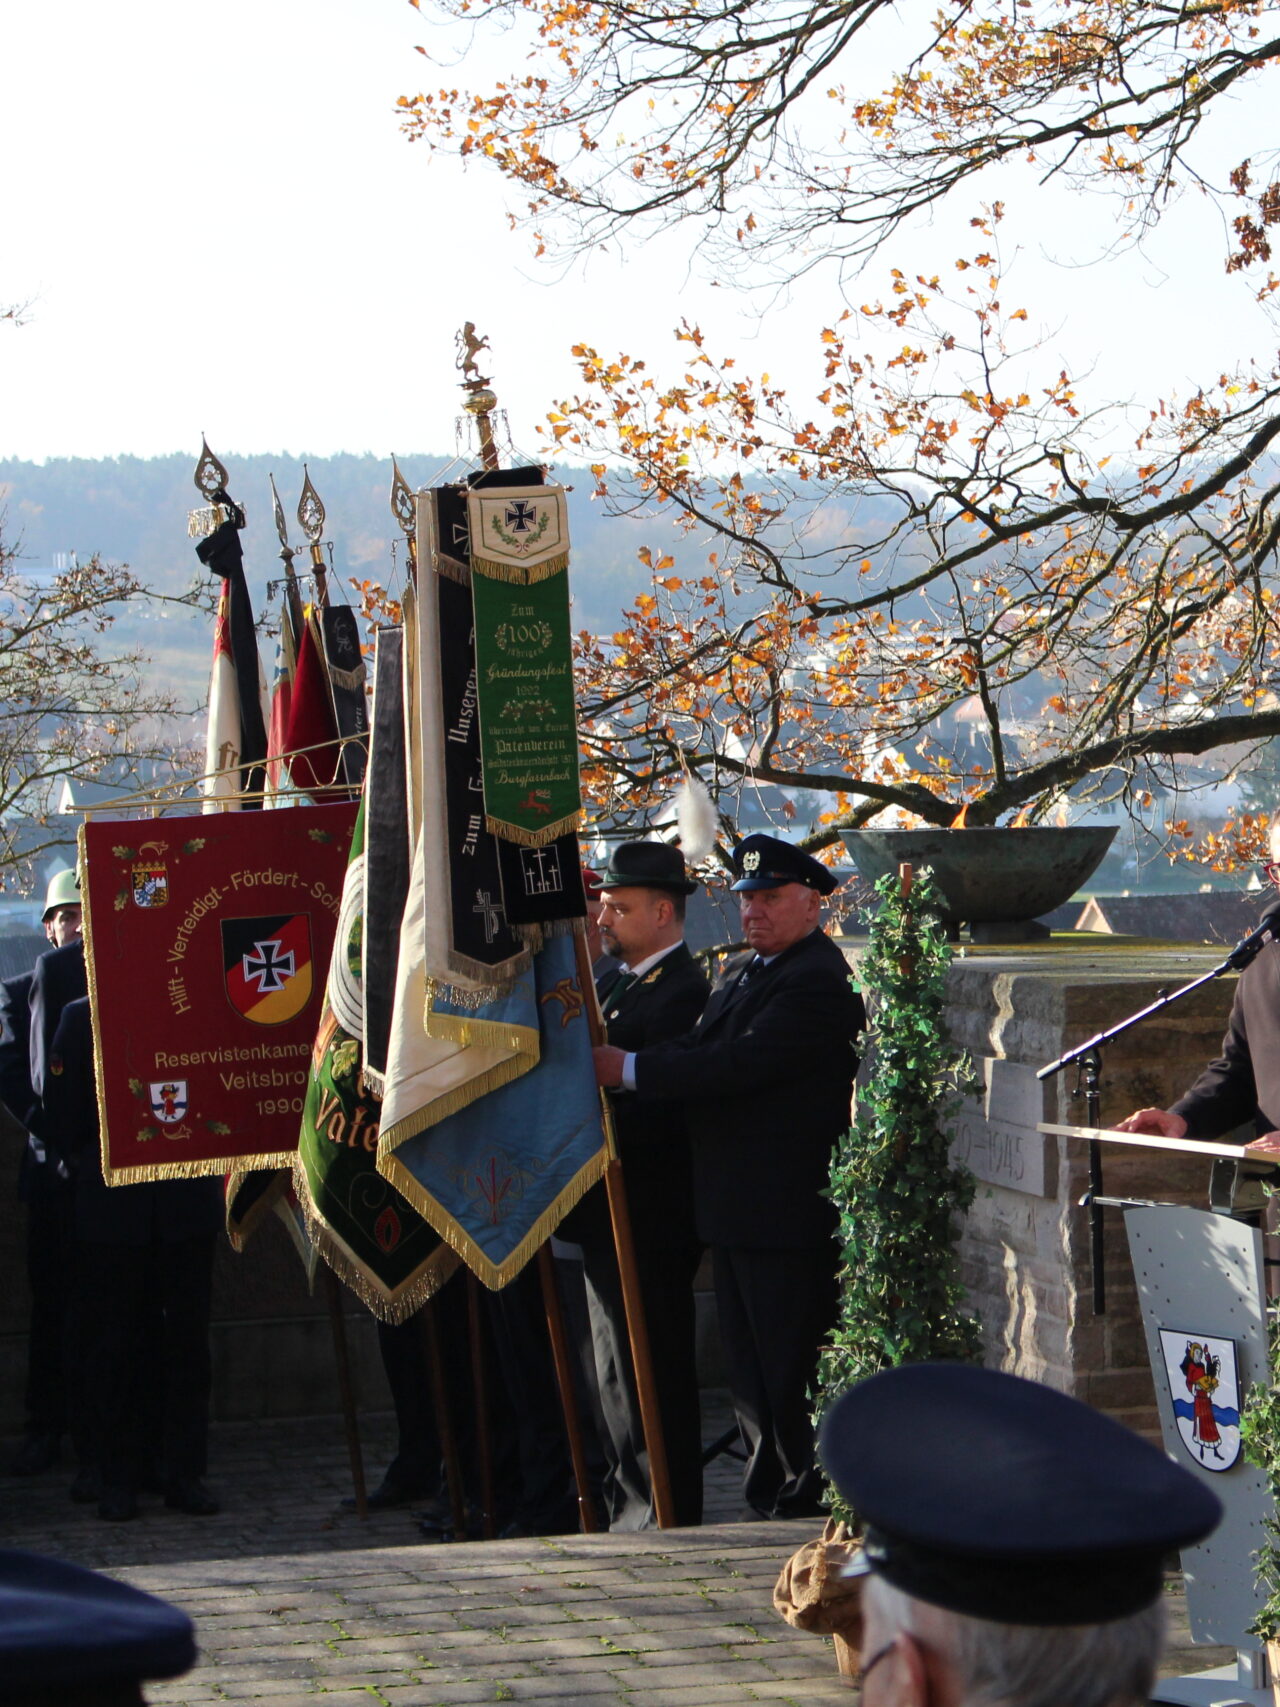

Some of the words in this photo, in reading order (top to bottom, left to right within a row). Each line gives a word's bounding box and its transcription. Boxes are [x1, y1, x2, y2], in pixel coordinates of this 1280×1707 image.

[508, 624, 541, 643] 100
[494, 739, 566, 756] Patenverein
[230, 867, 299, 891] Fördert
[310, 881, 341, 919] Sch
[167, 886, 223, 963] Verteidigt
[168, 977, 191, 1015] Hilft
[220, 1069, 308, 1091] Veitsbro
[256, 1097, 304, 1115] 1990
[315, 1088, 380, 1152] Vate
